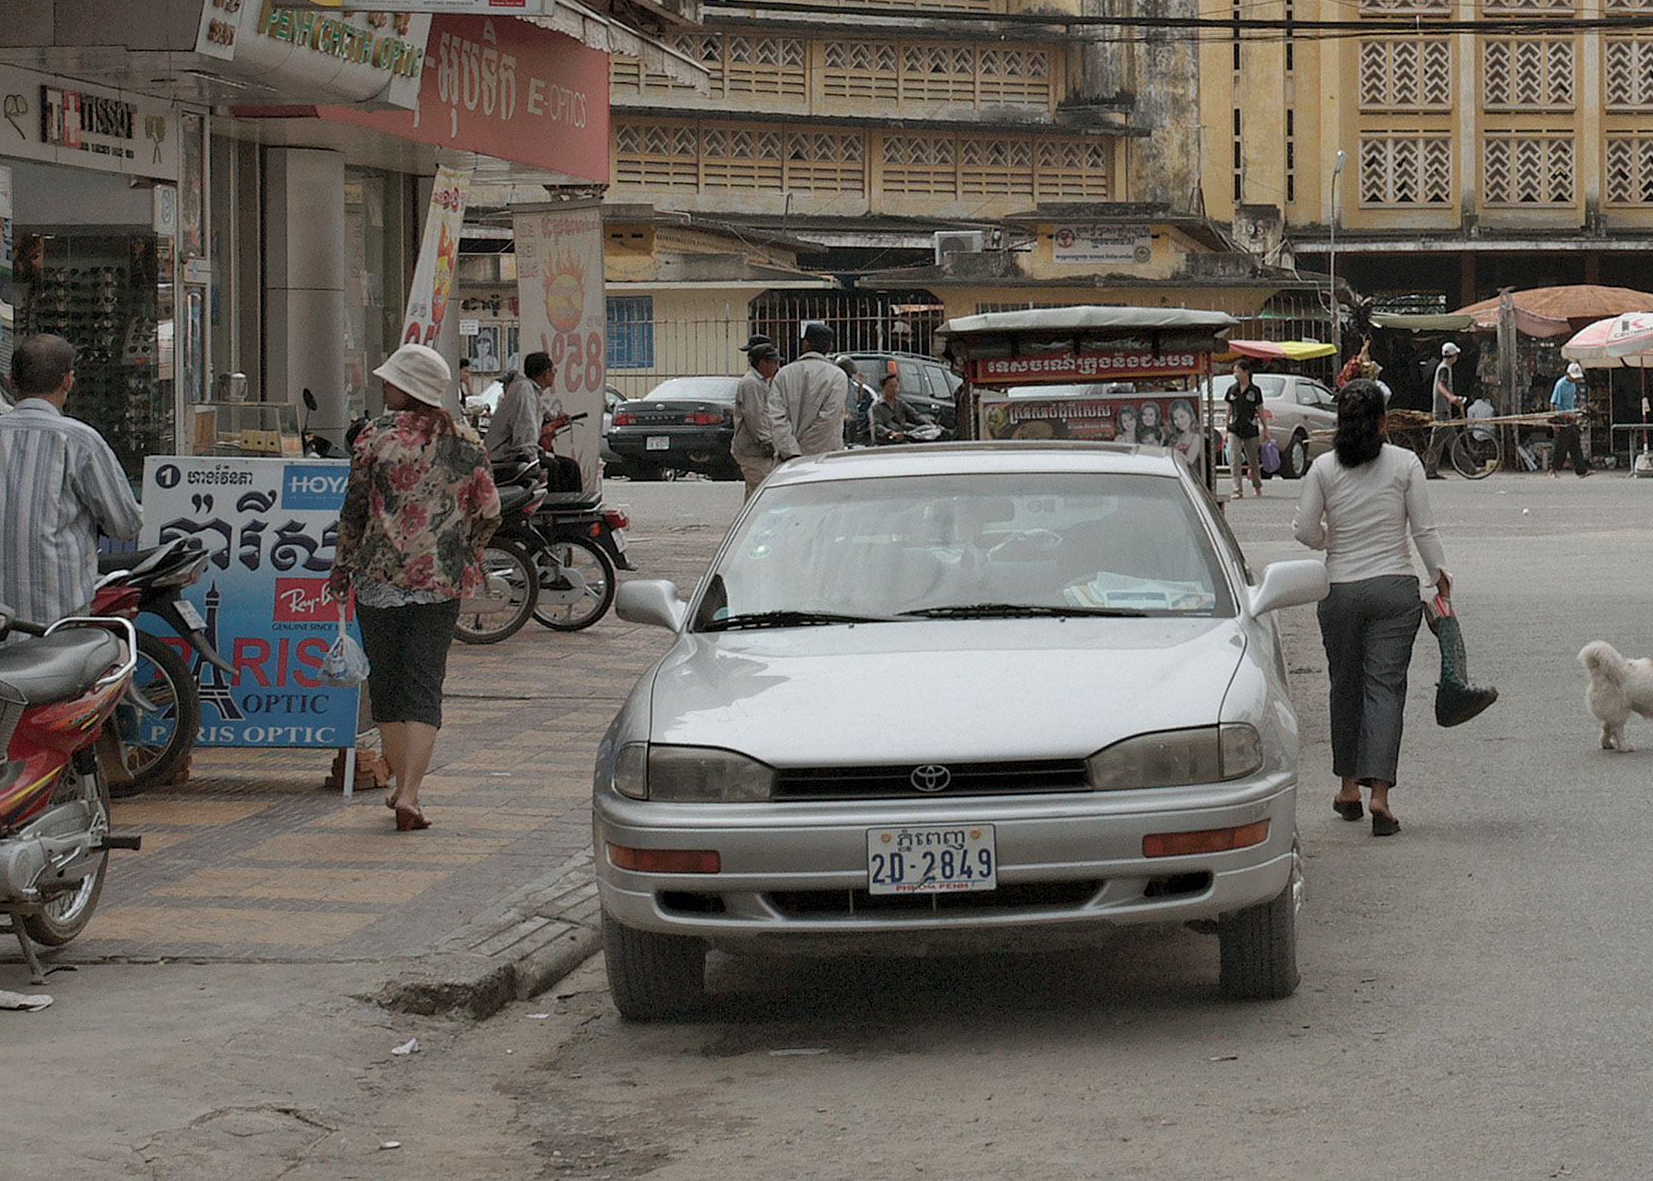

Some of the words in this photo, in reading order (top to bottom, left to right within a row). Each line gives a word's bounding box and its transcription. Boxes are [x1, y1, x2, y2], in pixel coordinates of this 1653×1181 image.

[267, 6, 315, 47] PENH
[318, 17, 374, 65] CHETH
[527, 77, 587, 129] E-OPTICS
[308, 622, 333, 631] SINCE
[242, 693, 330, 715] OPTIC
[243, 726, 336, 744] OPTIC
[871, 848, 992, 884] 2D-2849
[938, 882, 969, 890] PENH
